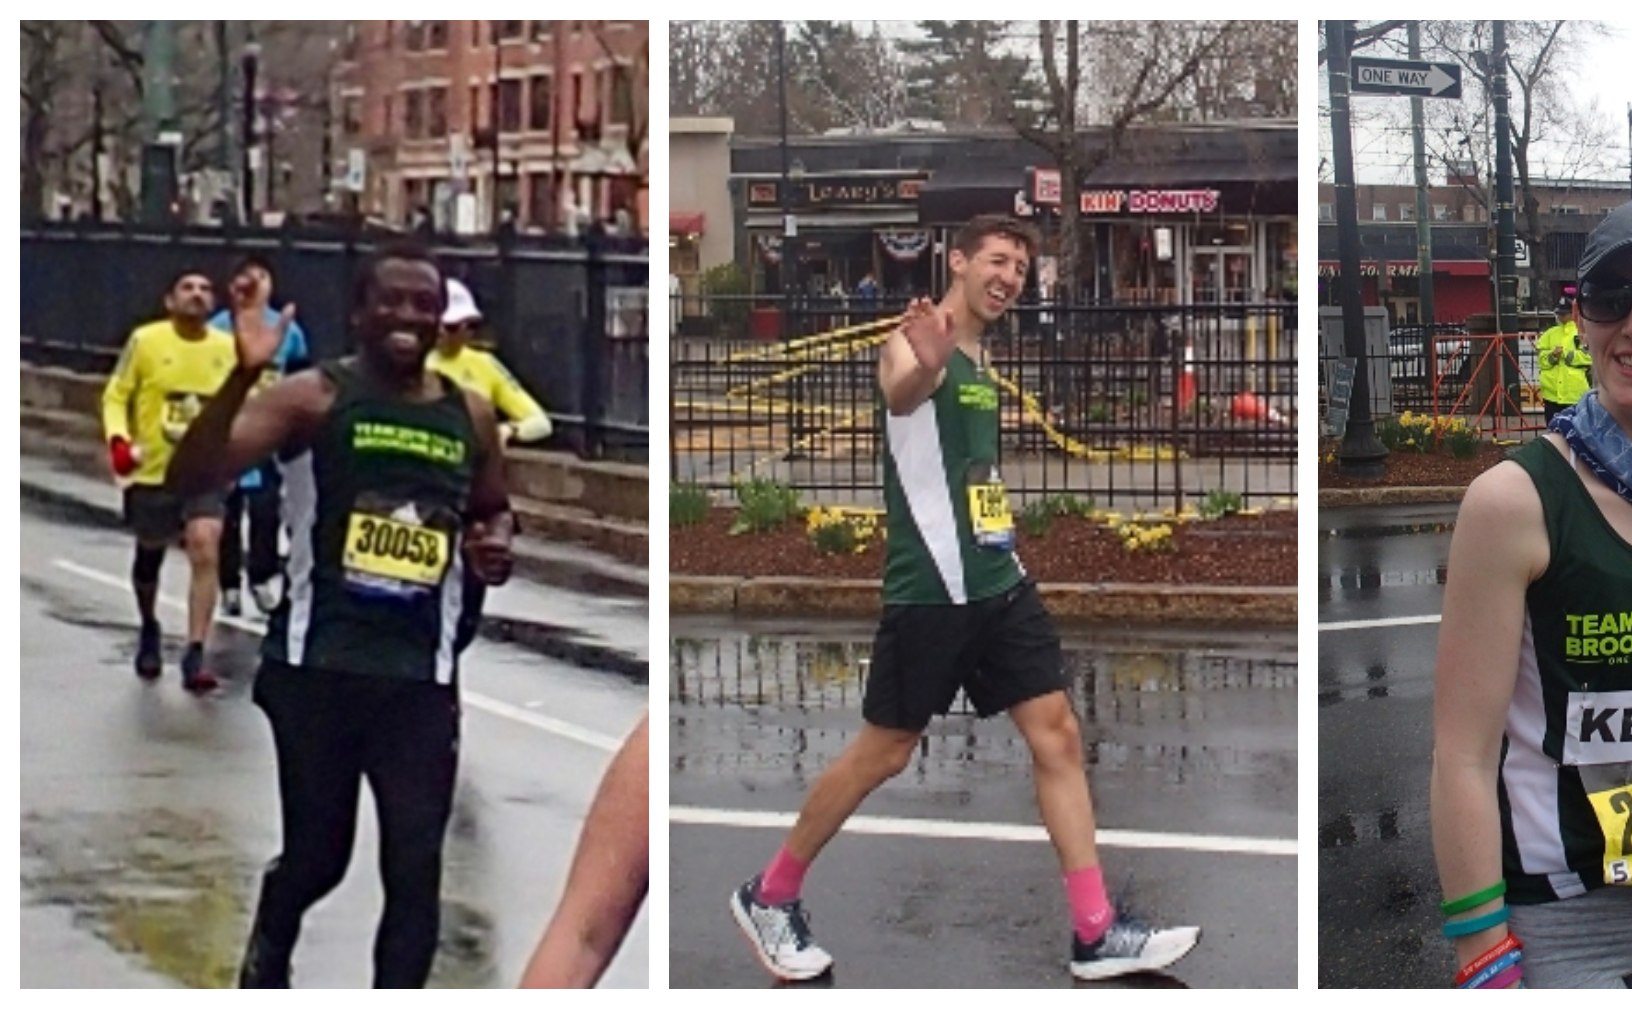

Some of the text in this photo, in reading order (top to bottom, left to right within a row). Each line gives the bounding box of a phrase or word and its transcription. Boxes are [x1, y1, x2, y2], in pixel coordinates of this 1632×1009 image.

[1362, 69, 1428, 86] ONE WAY
[1080, 190, 1219, 213] KIN' DONUTS
[356, 519, 440, 568] 30058
[1612, 863, 1629, 884] 5
